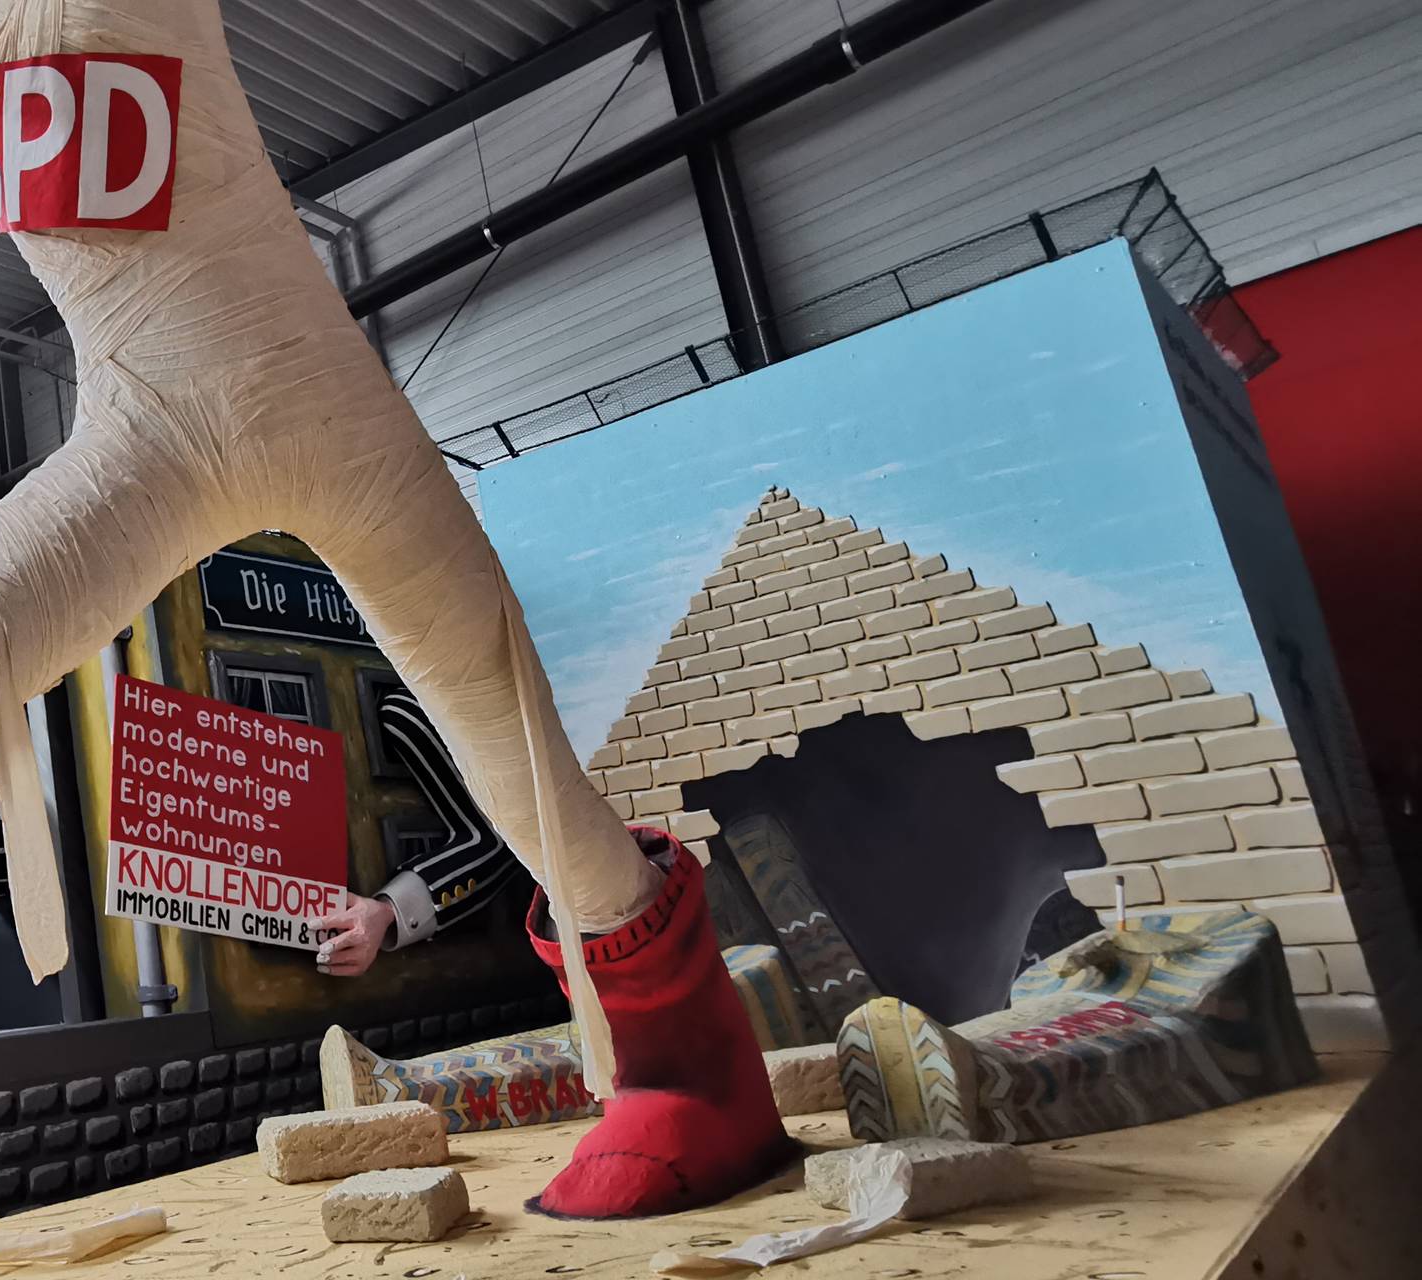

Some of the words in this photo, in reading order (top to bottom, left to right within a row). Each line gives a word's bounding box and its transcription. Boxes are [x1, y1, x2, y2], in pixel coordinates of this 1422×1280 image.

[239, 569, 287, 615] Die
[123, 683, 182, 718] Hier
[196, 710, 324, 757] entstehen
[121, 745, 291, 811] hochwertige
[122, 720, 247, 767] moderne
[261, 755, 309, 782] und
[120, 777, 280, 832] Eigentums-
[120, 816, 282, 867] wohnungen
[118, 846, 340, 918] KNOLLENDORF
[116, 888, 230, 931] IMMOBILIEN
[241, 912, 292, 942] GMBH
[298, 922, 310, 944] &
